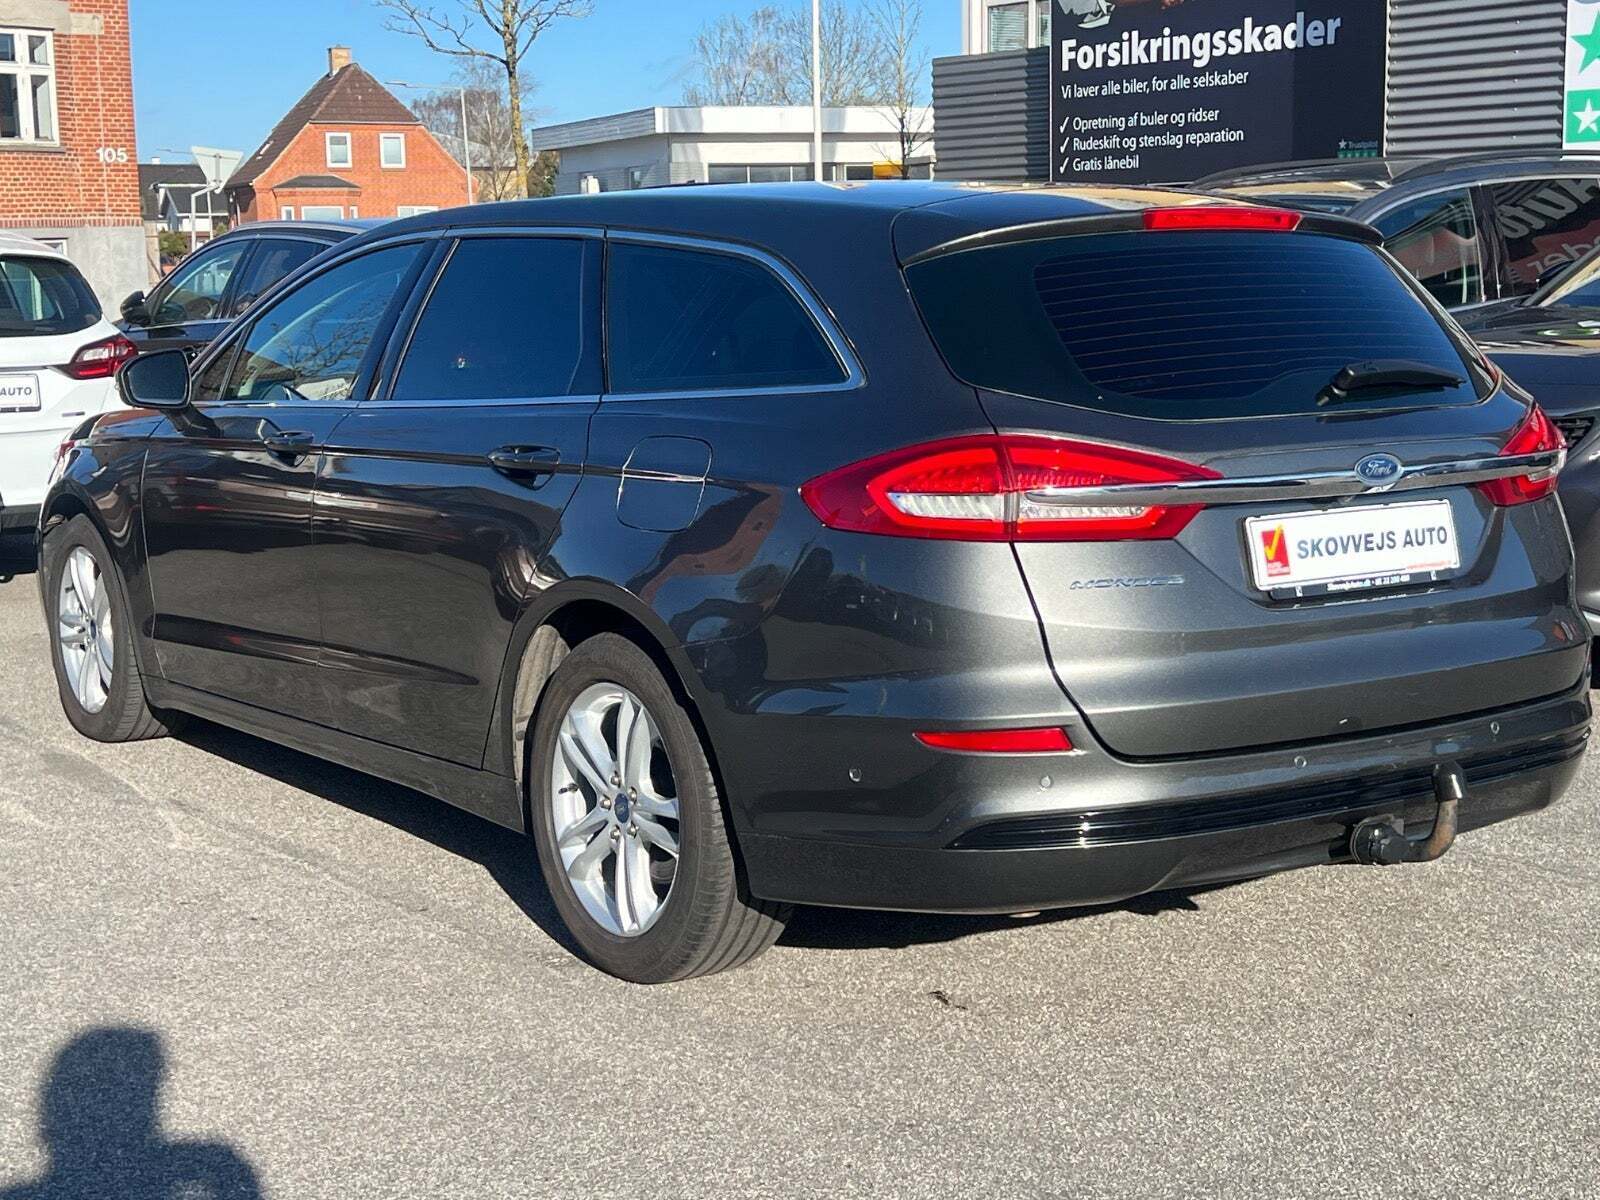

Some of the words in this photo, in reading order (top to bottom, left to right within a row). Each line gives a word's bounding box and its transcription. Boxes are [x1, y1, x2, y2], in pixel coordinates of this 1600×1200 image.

[1061, 11, 1341, 72] Forsikringsskader
[1061, 84, 1072, 99] Vi
[1074, 83, 1099, 98] laver
[1101, 81, 1121, 96] alle
[1123, 79, 1150, 95] biler,
[1152, 76, 1169, 91] for
[1170, 75, 1190, 90] alle
[1193, 69, 1249, 88] selskaber
[1073, 115, 1126, 133] Opretning
[1128, 112, 1139, 127] af
[1140, 111, 1169, 126] buler
[1170, 113, 1185, 127] og
[1187, 108, 1219, 123] ridser
[1073, 135, 1120, 151] Rudeskift
[1122, 137, 1137, 151] og
[1139, 132, 1183, 148] stenslag
[1186, 128, 1244, 146] reparation
[96, 147, 128, 163] 105
[1072, 156, 1102, 171] Gratis
[1104, 154, 1139, 170] lånebil
[0, 386, 33, 396] AUTO
[1297, 531, 1397, 559] SKOVVEJS
[1403, 526, 1448, 548] AUTO
